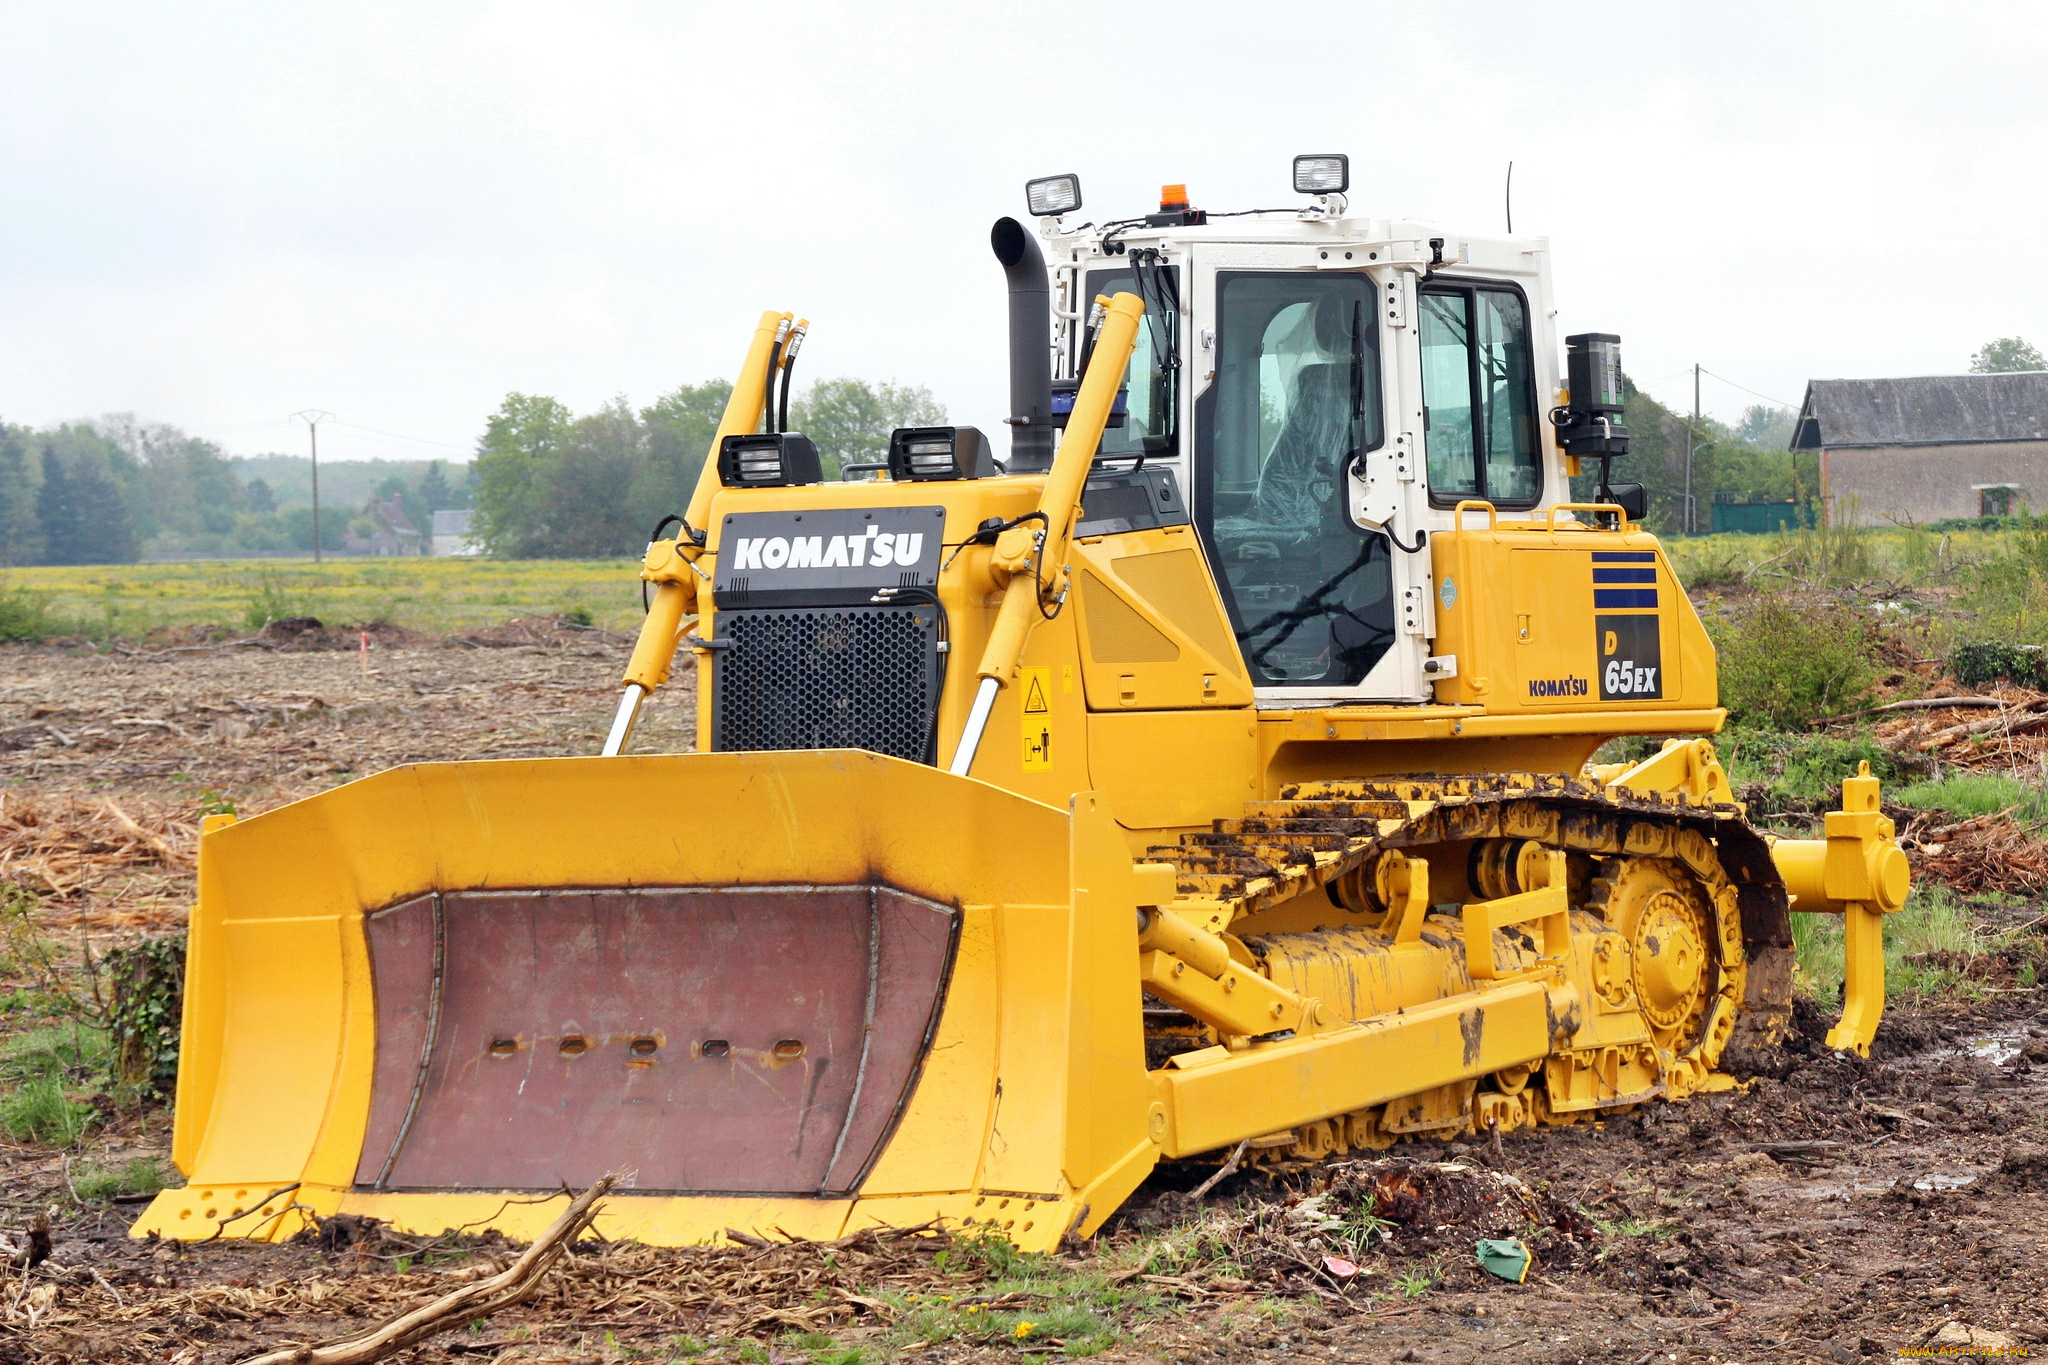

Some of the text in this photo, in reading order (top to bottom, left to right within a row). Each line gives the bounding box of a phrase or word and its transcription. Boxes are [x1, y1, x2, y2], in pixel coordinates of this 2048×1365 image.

[733, 524, 924, 570] KOMATSU
[1604, 630, 1618, 656] D
[1528, 674, 1588, 697] KOMATSU
[1604, 660, 1657, 694] 65EX
